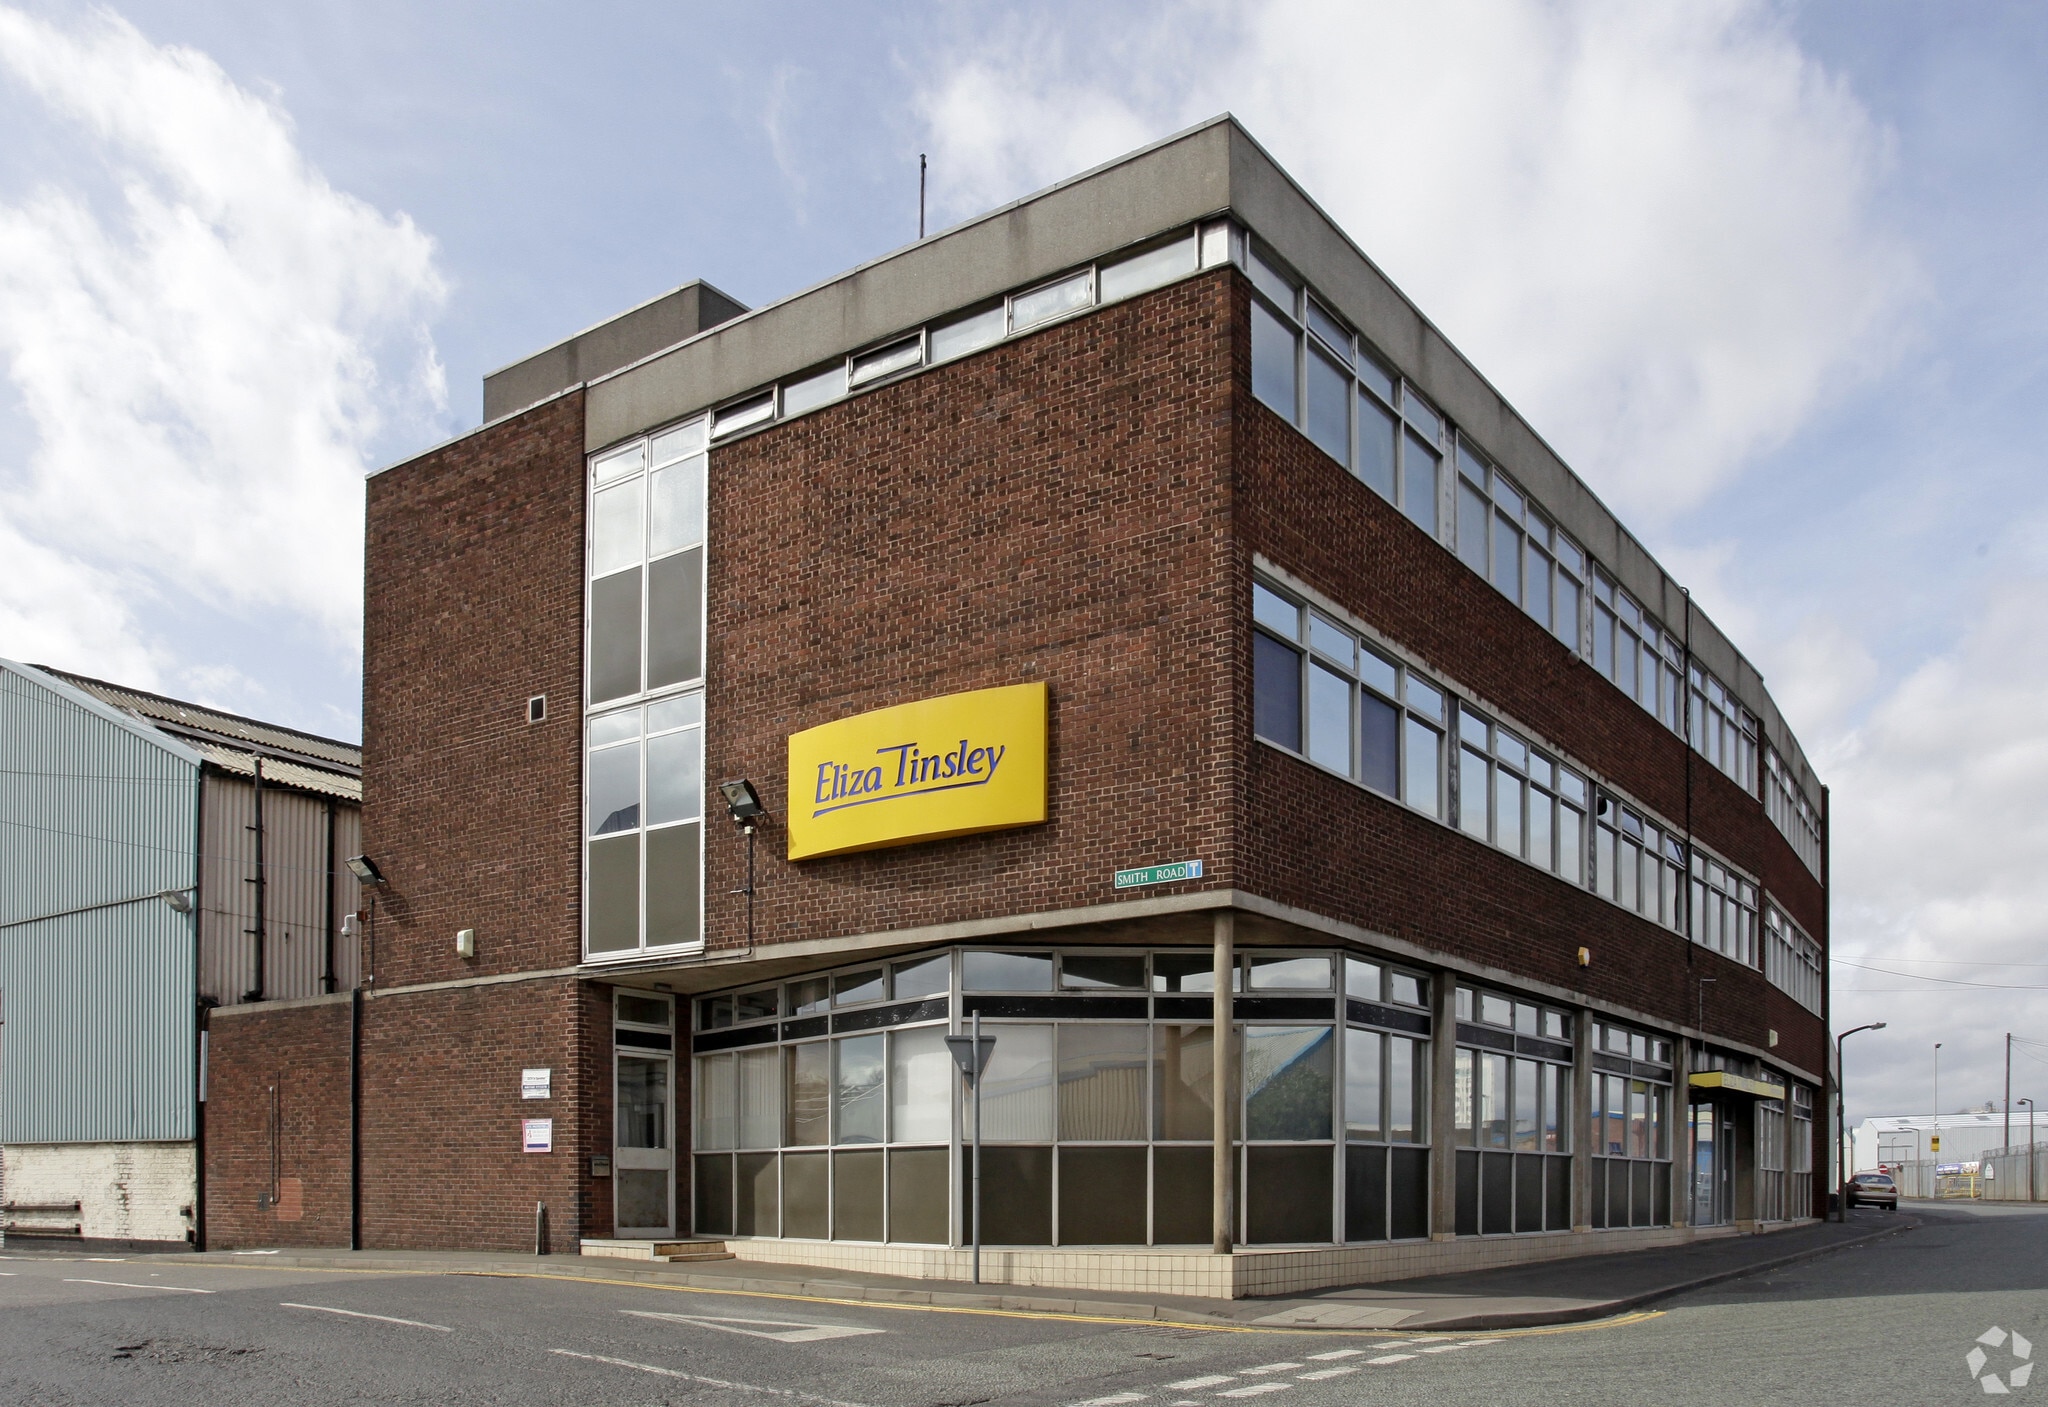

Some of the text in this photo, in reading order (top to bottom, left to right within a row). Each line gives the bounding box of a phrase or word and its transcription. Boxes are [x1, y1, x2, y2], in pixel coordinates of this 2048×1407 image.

[815, 739, 1006, 804] Eliza Tinsley
[1117, 866, 1186, 886] SMITH ROAD
